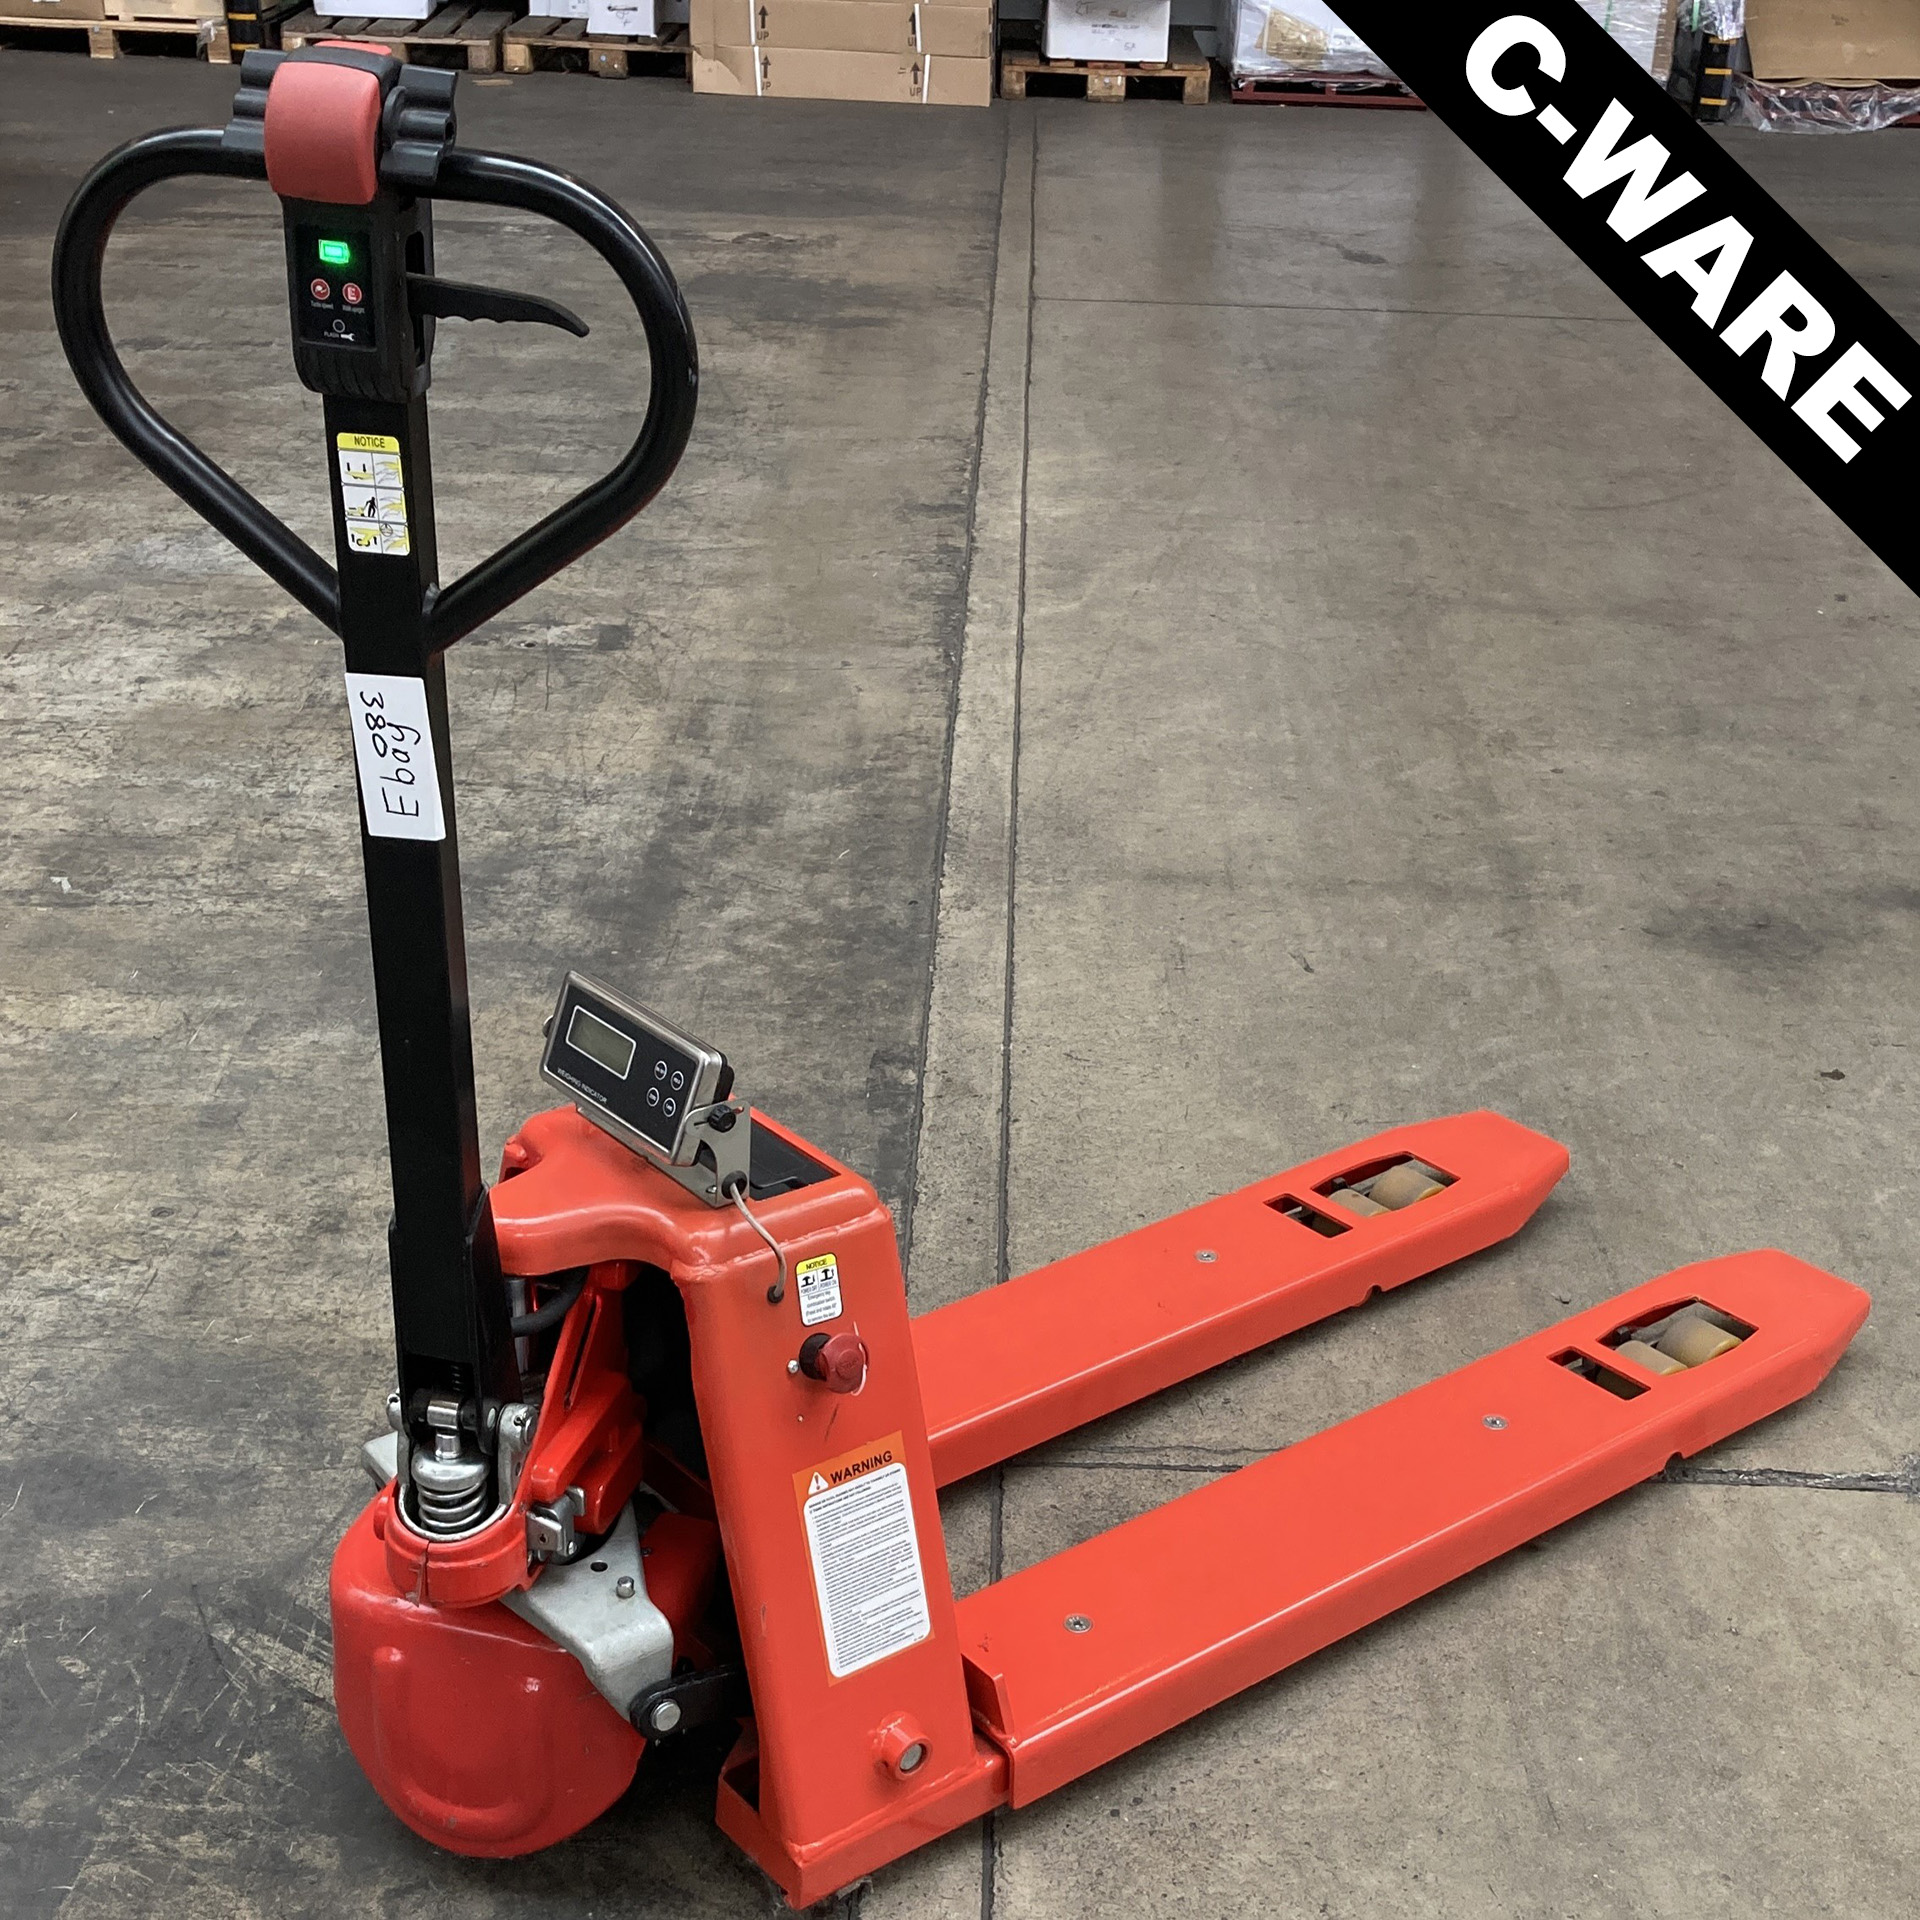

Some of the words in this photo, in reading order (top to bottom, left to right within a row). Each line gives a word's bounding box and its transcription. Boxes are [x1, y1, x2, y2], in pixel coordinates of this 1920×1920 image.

[756, 31, 770, 41] UP
[909, 86, 922, 97] UP
[347, 286, 357, 300] E
[354, 435, 386, 449] NOTICE
[359, 690, 389, 759] 380
[379, 721, 422, 818] Ebay
[581, 1083, 607, 1104] INDICATOR
[806, 1258, 827, 1270] NOTICE
[829, 1450, 893, 1485] WARNING
